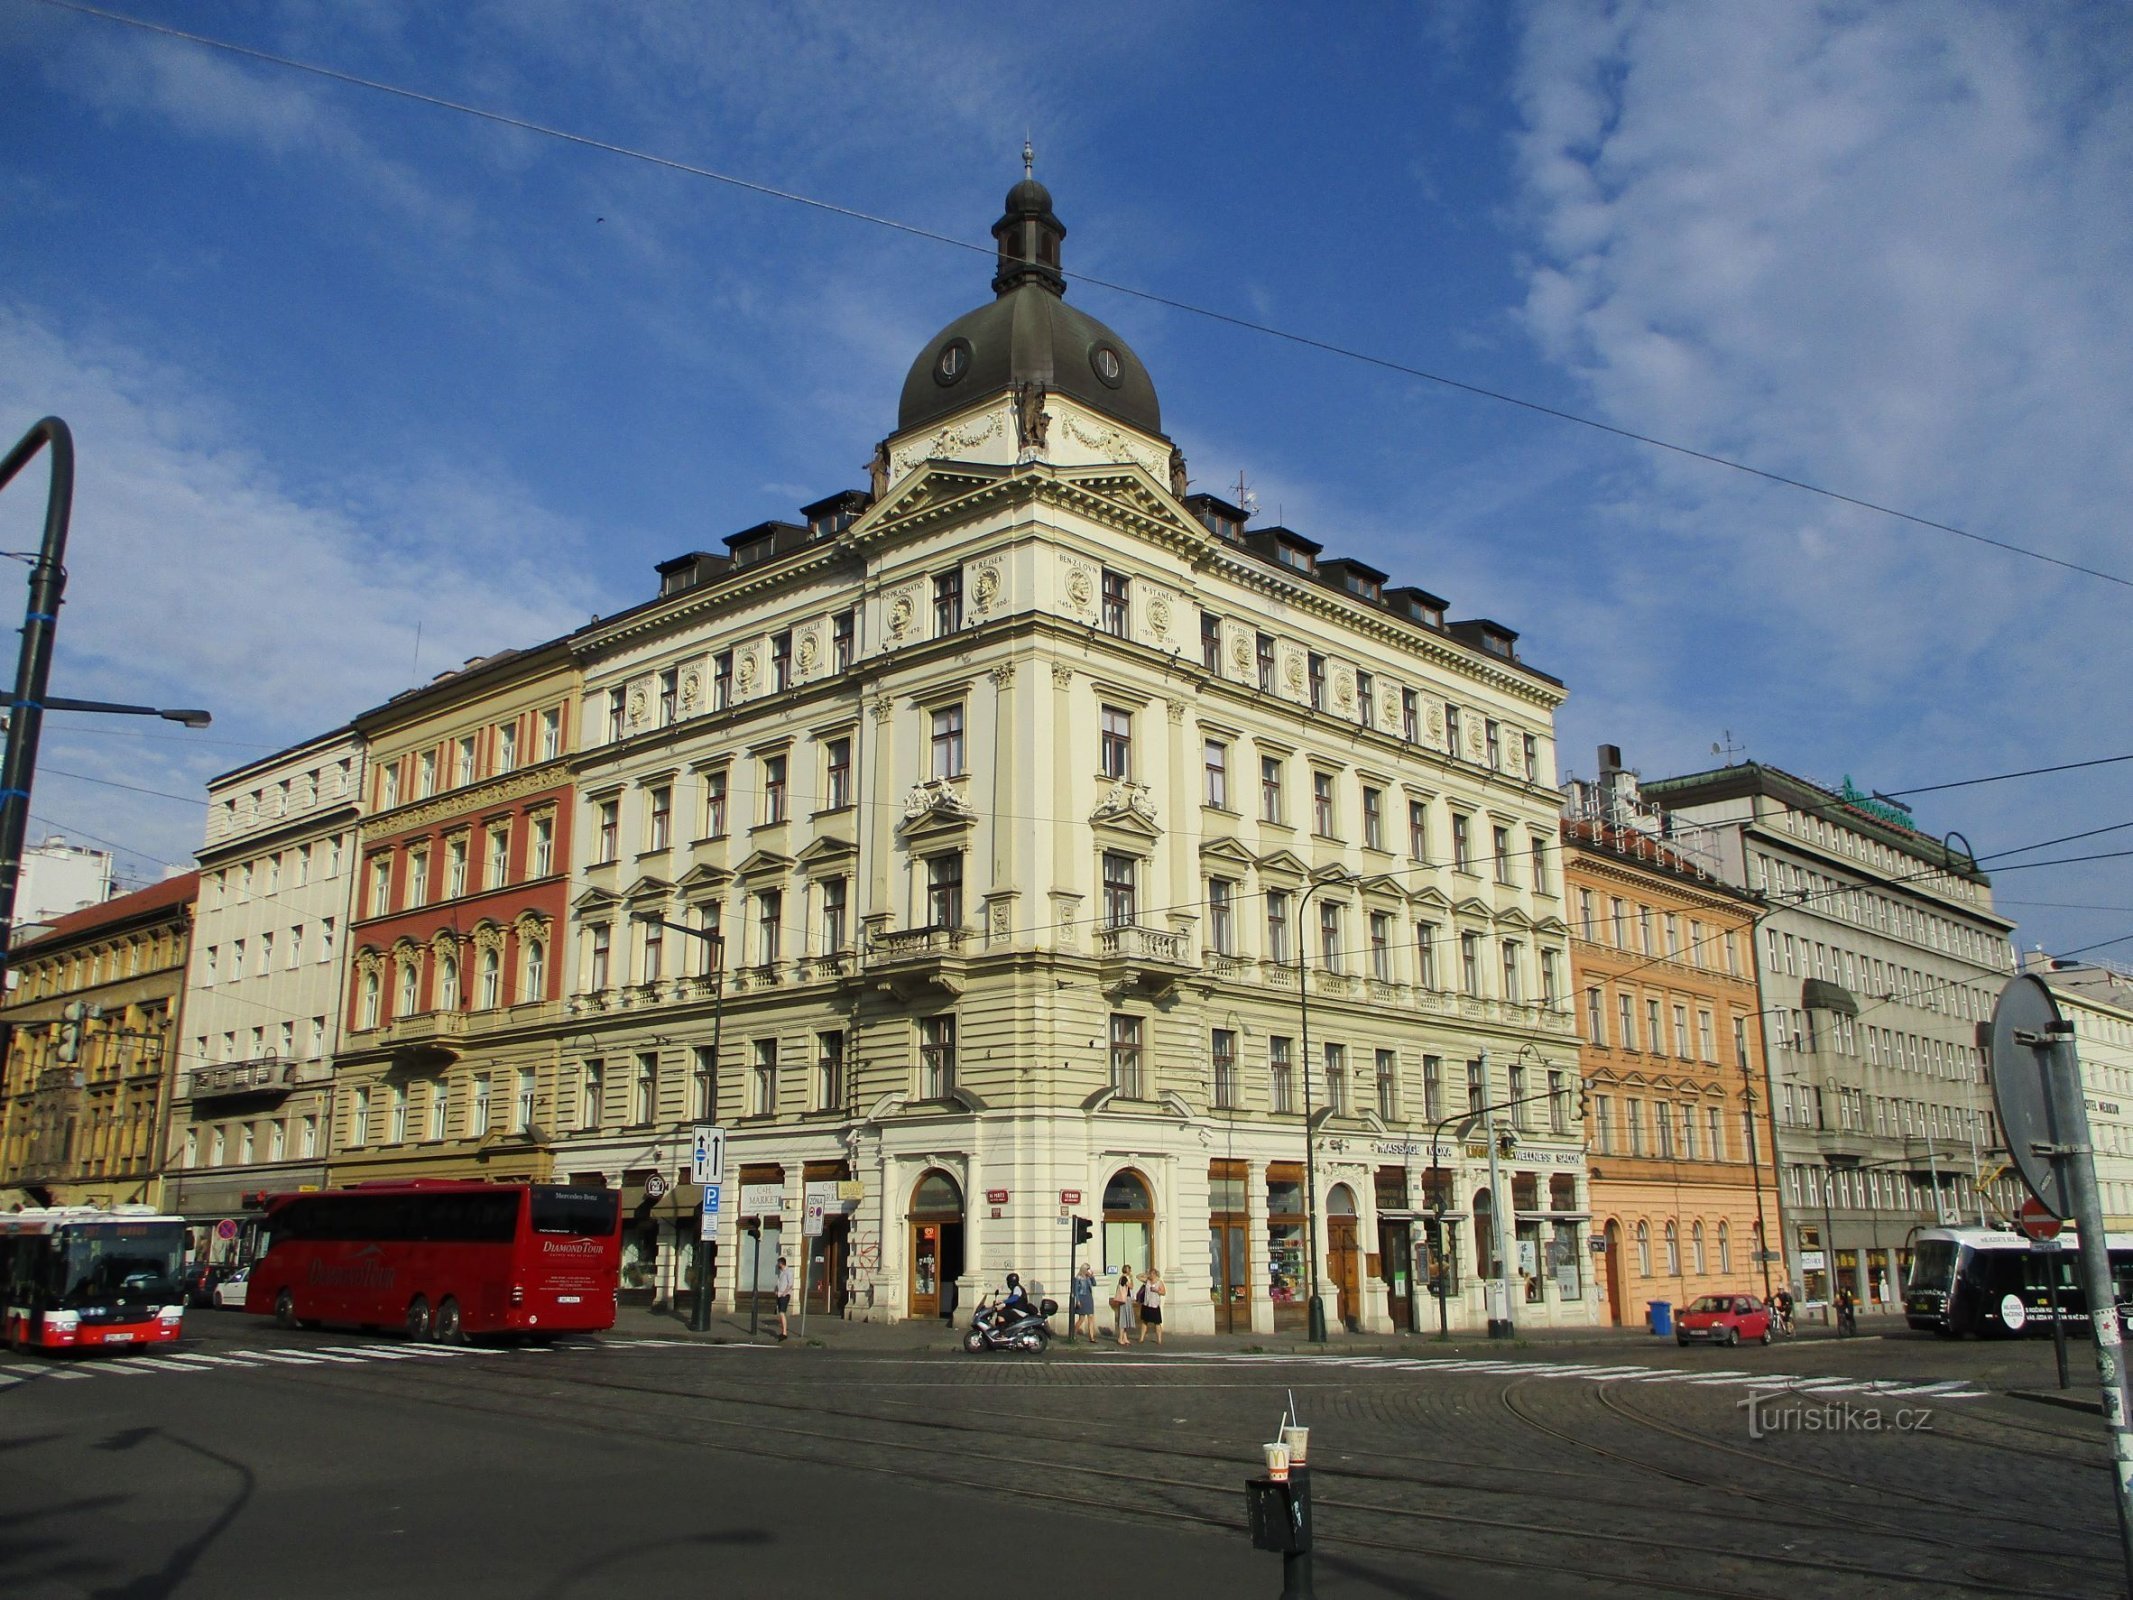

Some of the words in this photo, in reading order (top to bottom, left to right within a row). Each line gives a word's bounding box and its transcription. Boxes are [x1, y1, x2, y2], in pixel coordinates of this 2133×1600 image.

[1377, 1142, 1420, 1156] MASSAGE
[1515, 1150, 1551, 1163] WELLNESS
[749, 1195, 780, 1205] MARKET
